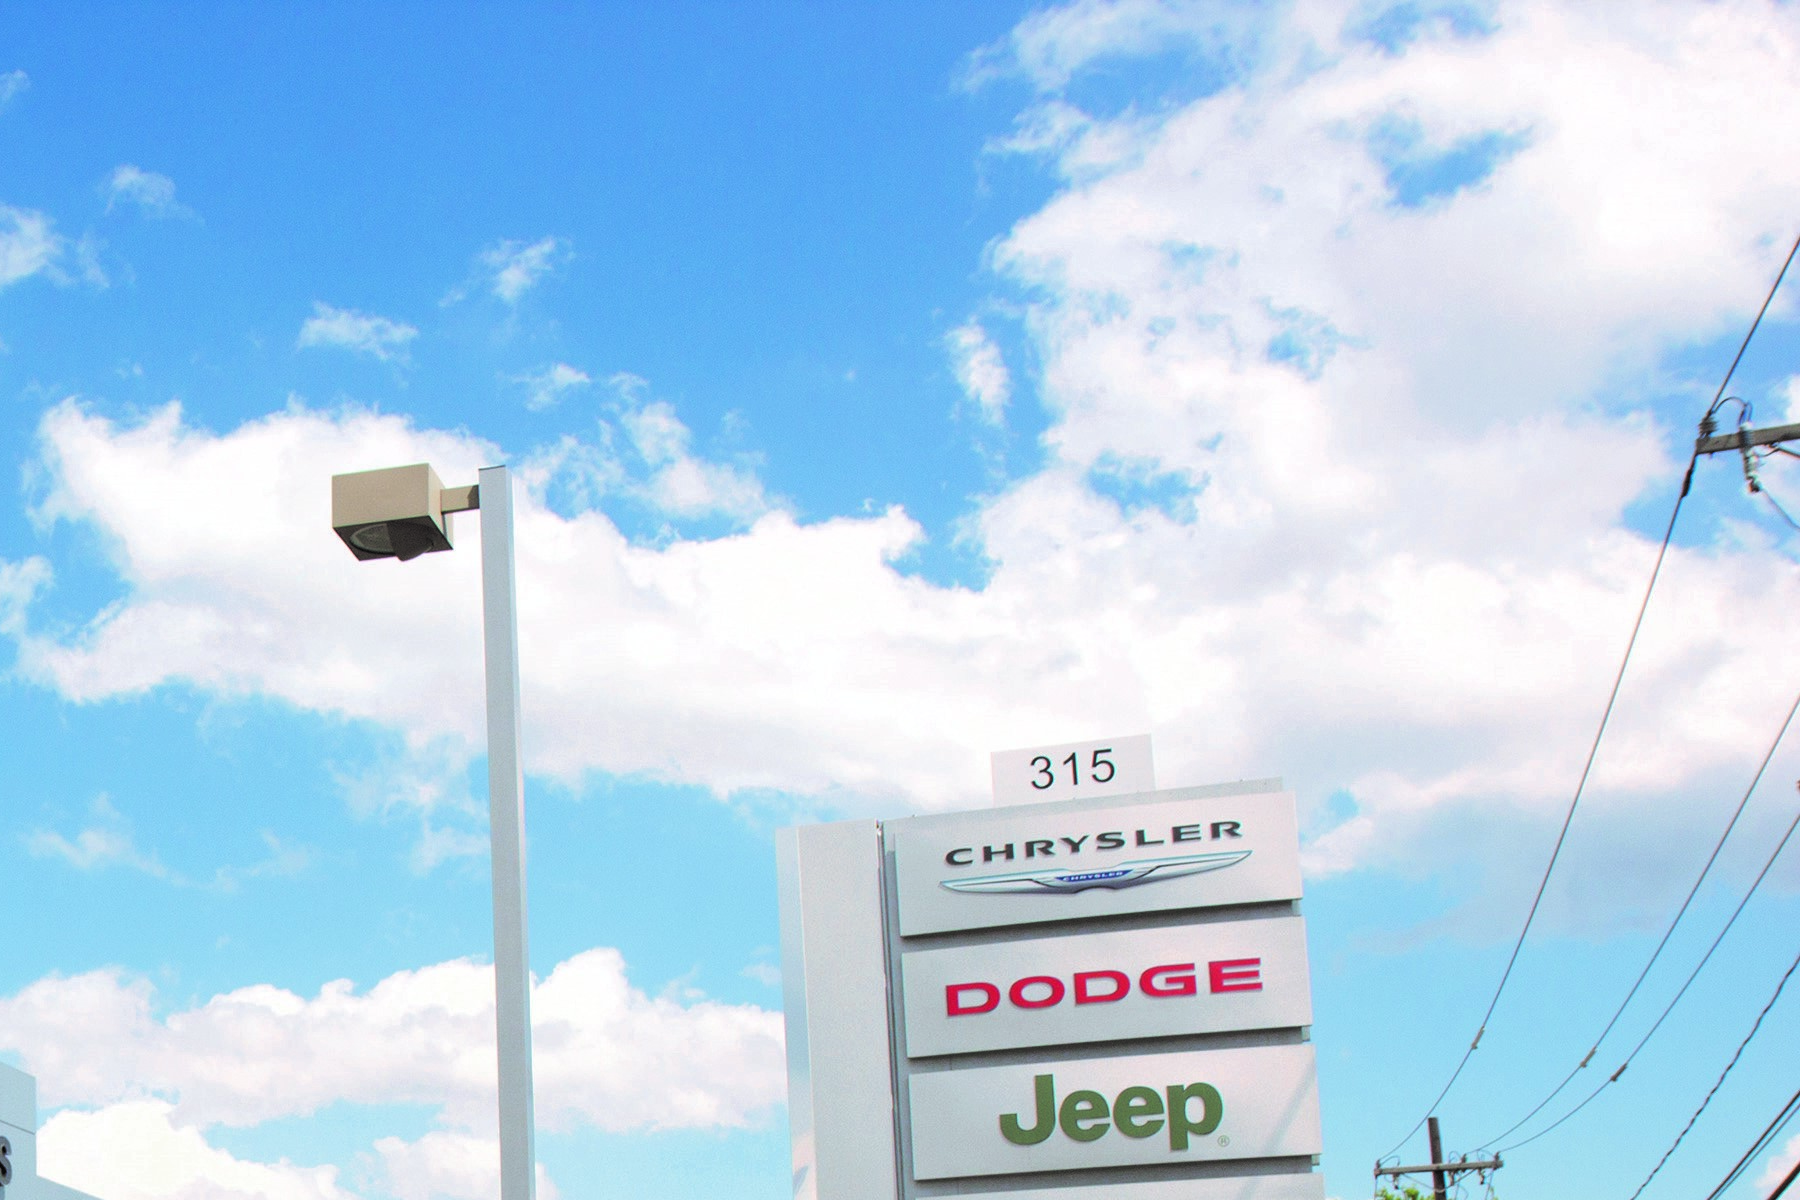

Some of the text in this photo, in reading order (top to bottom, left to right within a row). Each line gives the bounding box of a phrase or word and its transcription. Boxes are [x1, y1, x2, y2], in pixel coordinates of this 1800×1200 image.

[1030, 748, 1115, 789] 315
[945, 820, 1243, 866] CHRYSLER
[1062, 870, 1124, 882] CHRYSLER
[945, 957, 1263, 1017] DODGE
[999, 1074, 1223, 1151] Jeep
